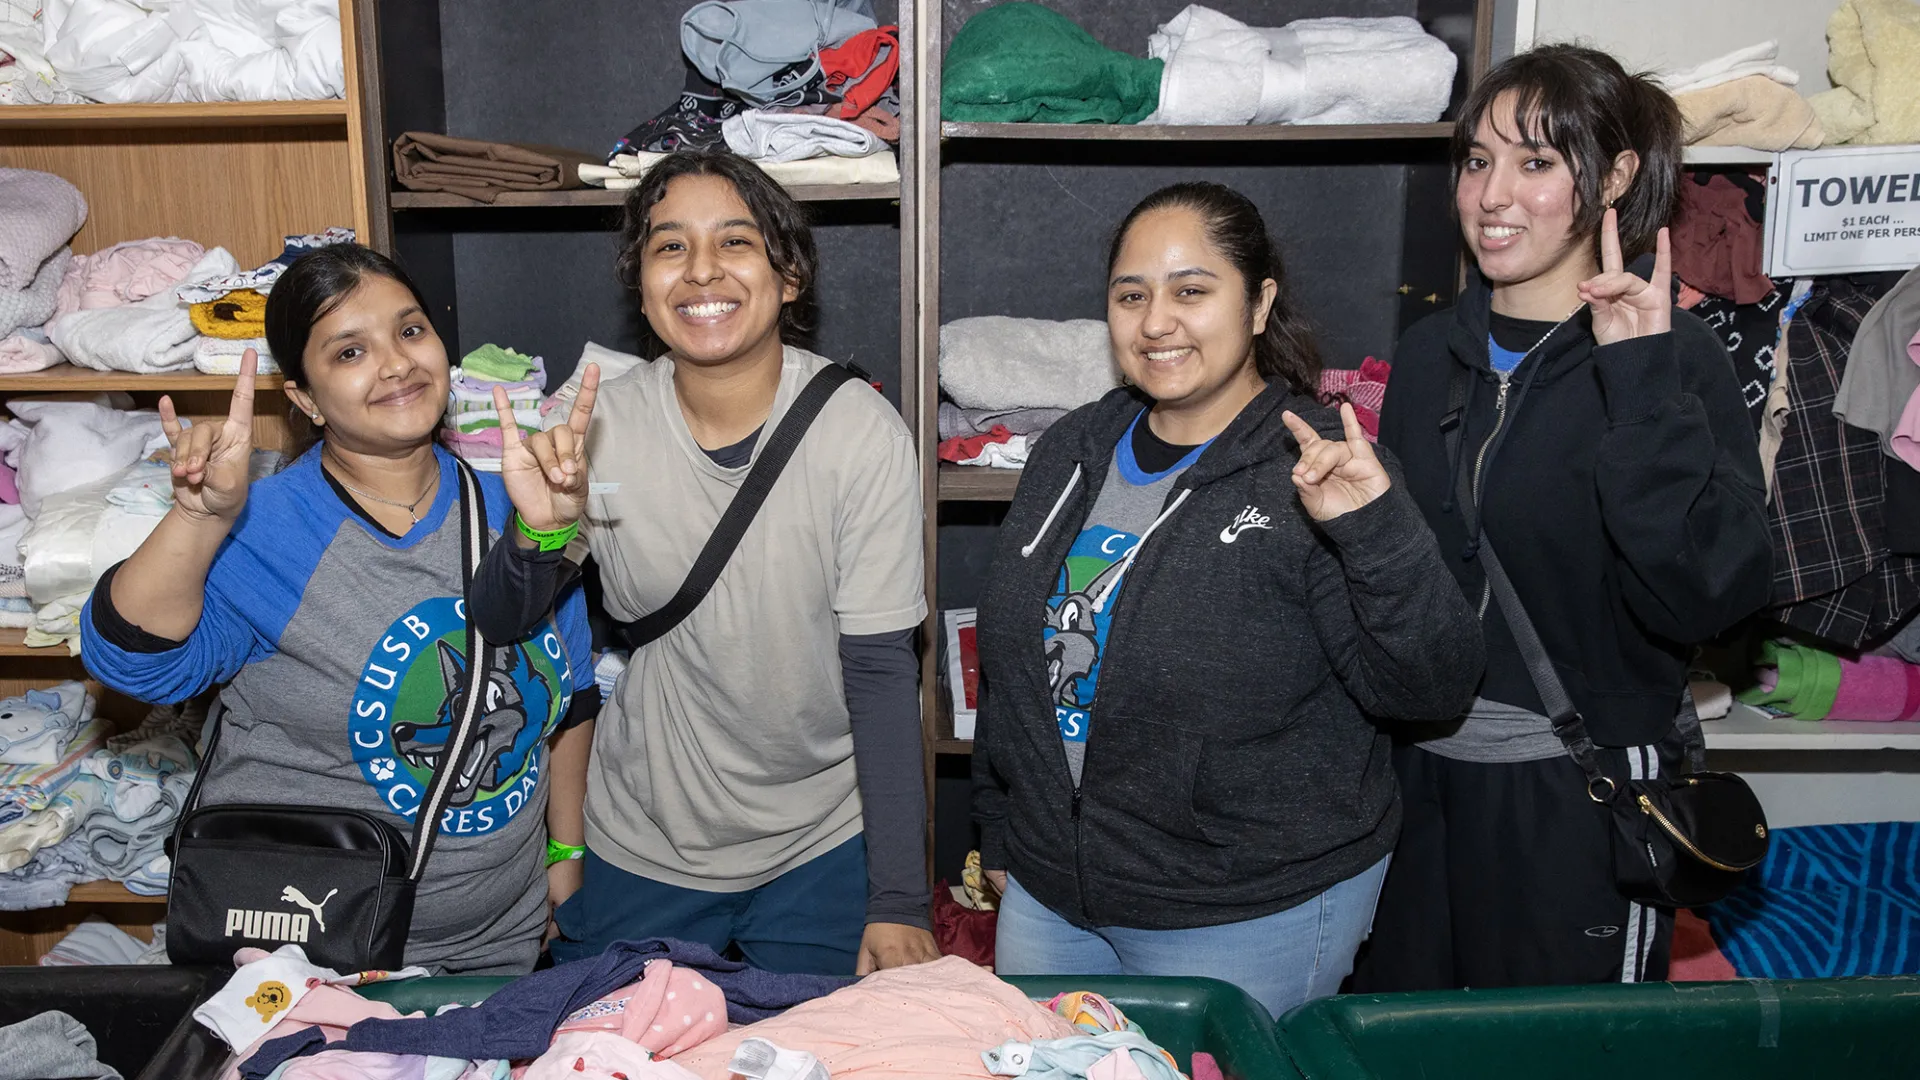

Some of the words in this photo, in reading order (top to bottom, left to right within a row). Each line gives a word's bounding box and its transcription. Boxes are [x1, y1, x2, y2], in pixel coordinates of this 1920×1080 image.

[1841, 217, 1855, 227] $1
[1859, 215, 1890, 226] EACH
[1804, 231, 1837, 242] LIMIT
[1840, 229, 1864, 240] ONE
[1867, 228, 1890, 238] PER
[355, 614, 430, 748] CSUSB
[225, 908, 310, 943] PUMA
